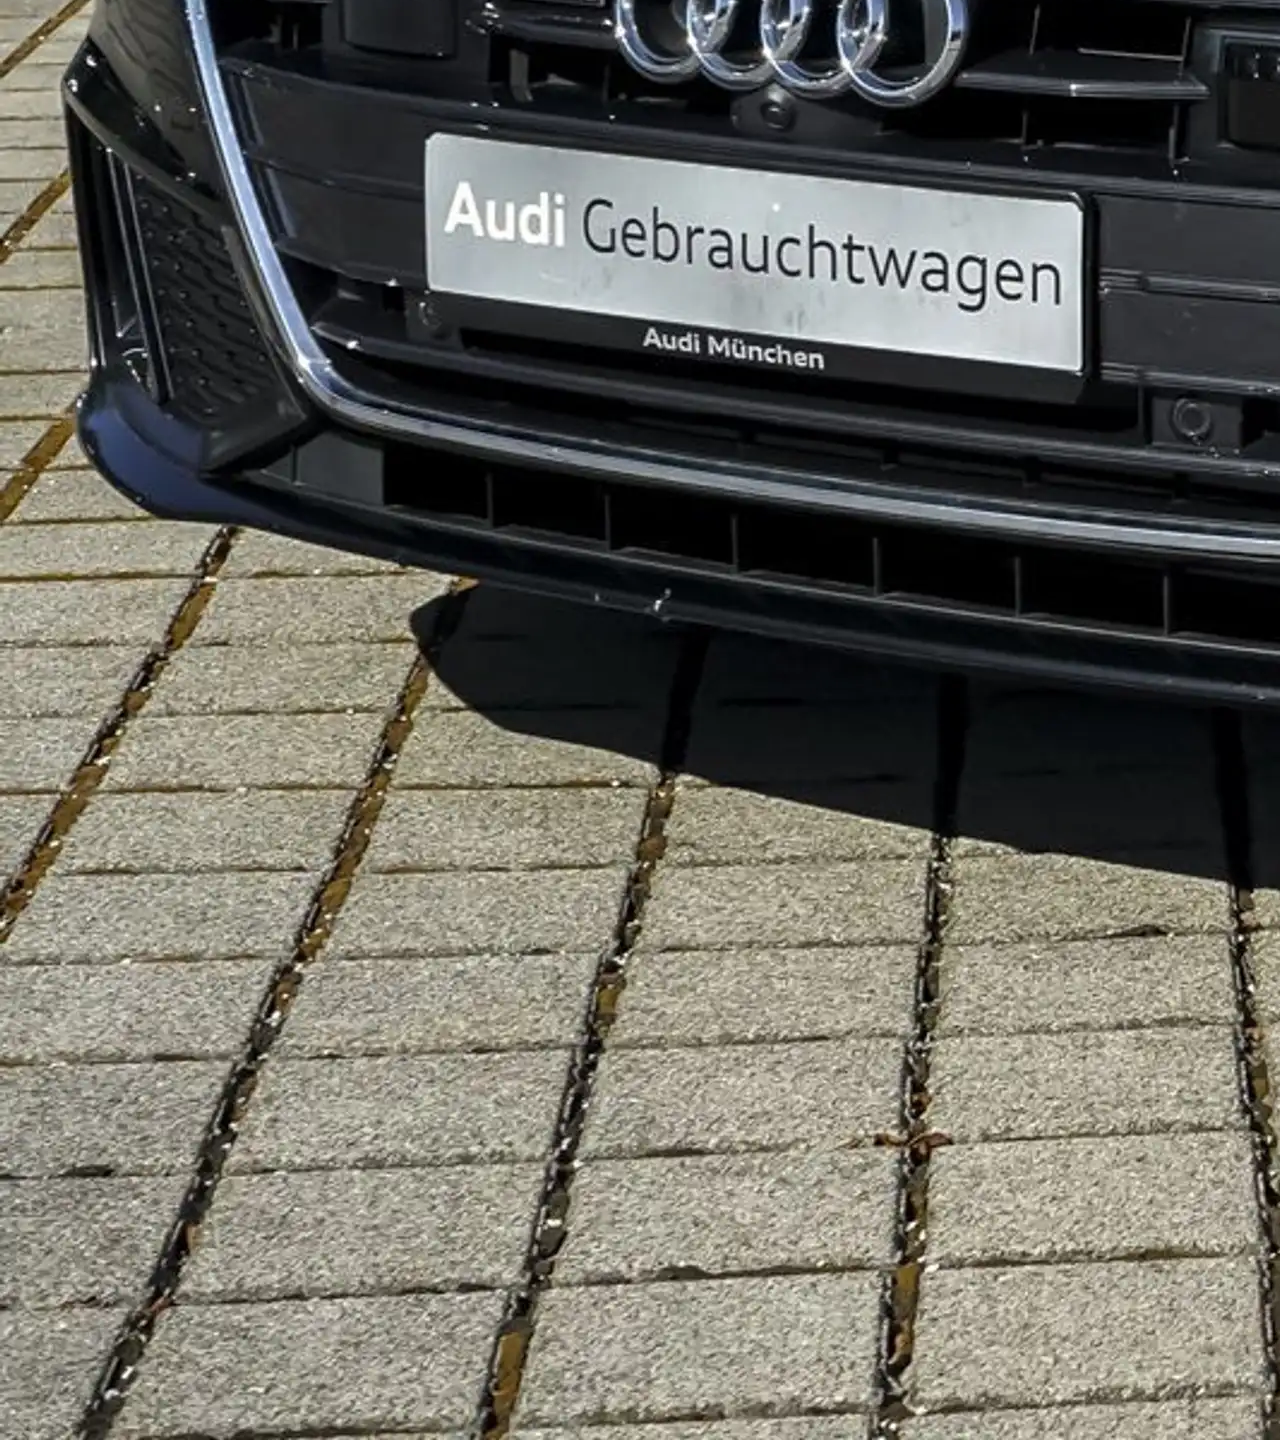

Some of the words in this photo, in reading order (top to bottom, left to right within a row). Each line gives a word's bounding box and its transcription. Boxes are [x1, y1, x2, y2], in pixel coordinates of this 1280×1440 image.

[444, 180, 566, 248] Audi
[582, 197, 1062, 313] Gebrauchtwagen
[643, 326, 701, 354] Audi
[707, 334, 825, 370] München
